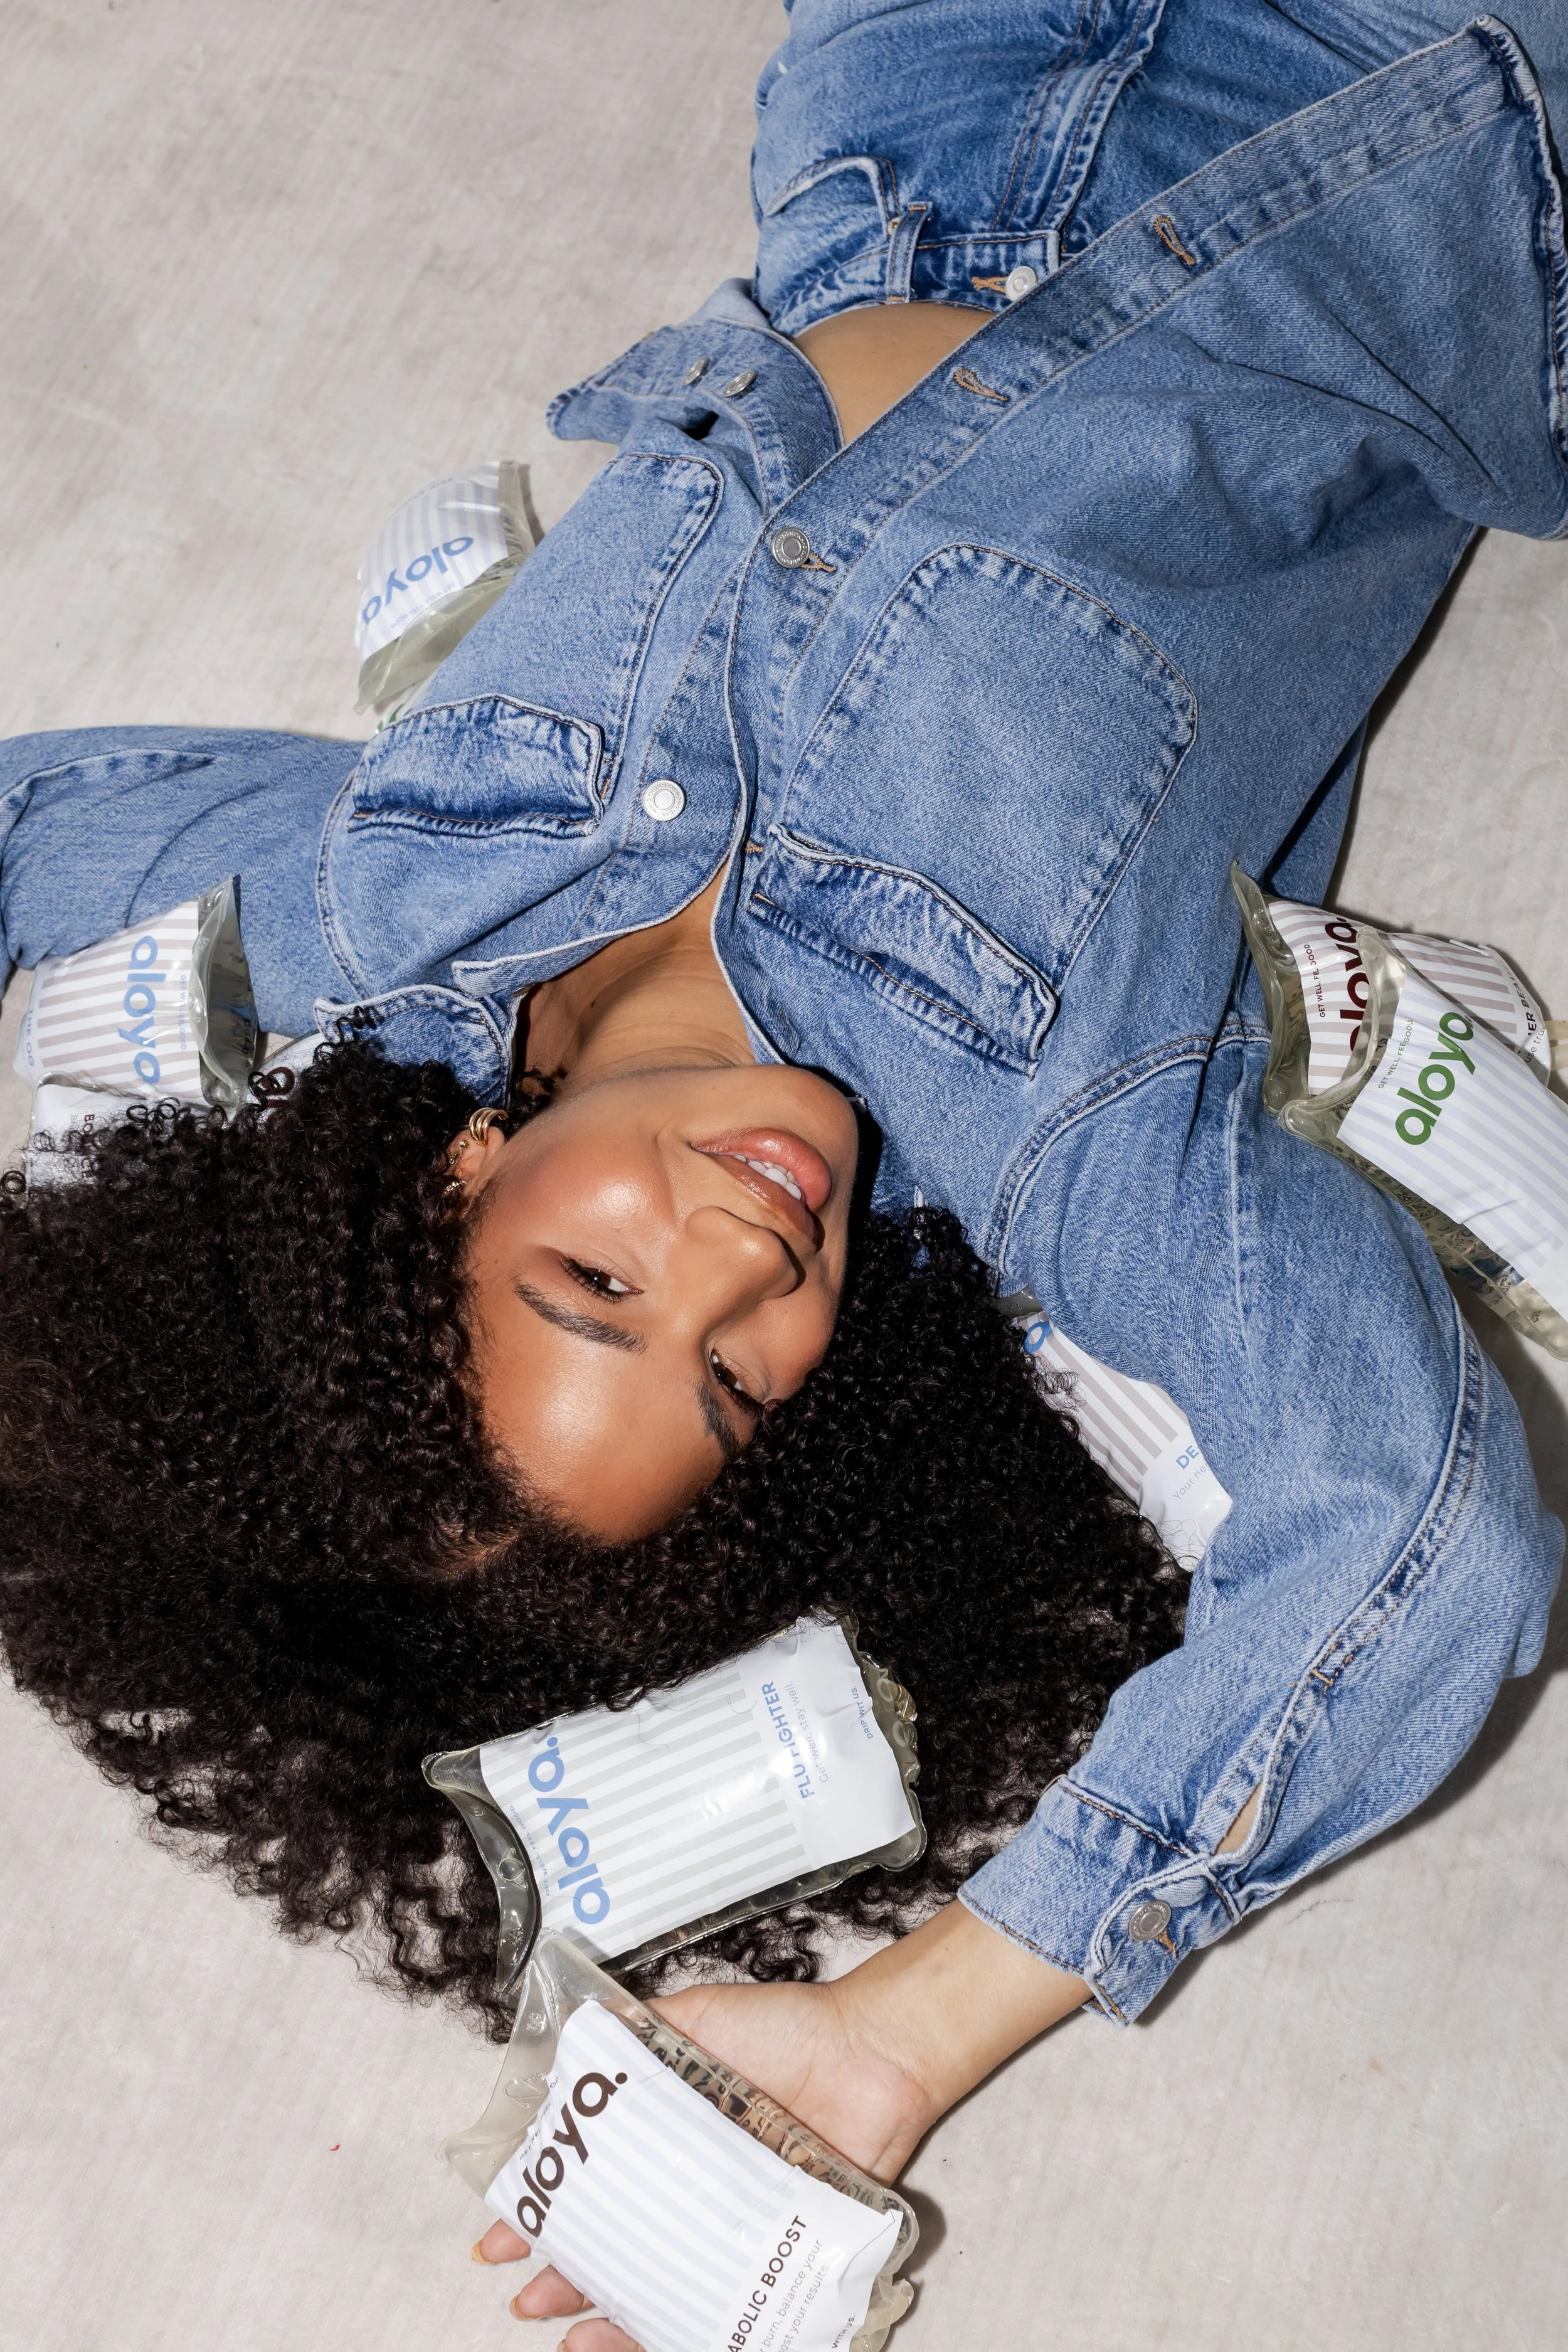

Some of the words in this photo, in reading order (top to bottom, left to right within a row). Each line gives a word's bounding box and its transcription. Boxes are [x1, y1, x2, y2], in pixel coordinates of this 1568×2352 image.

[363, 537, 474, 625] aloya
[117, 935, 166, 1084] aloya
[1378, 1078, 1387, 1089] GET
[1397, 1042, 1406, 1056] FEE
[1173, 1478, 1194, 1500] Your
[785, 1681, 800, 1706] well.
[851, 1685, 859, 1699] US.
[796, 1708, 809, 1731] stay
[861, 1720, 874, 1739] DRIP
[793, 1764, 815, 1799] FLU
[815, 1762, 828, 1783] Get
[528, 1737, 610, 1924] aloya.
[517, 2072, 628, 2238] aloya.
[761, 2215, 807, 2288] BOOST
[761, 2321, 783, 2348] burn,
[776, 2270, 806, 2317] balance
[803, 2240, 823, 2271] your
[790, 2306, 807, 2334] your
[832, 2328, 847, 2349] WITH
[846, 2314, 856, 2328] US.
